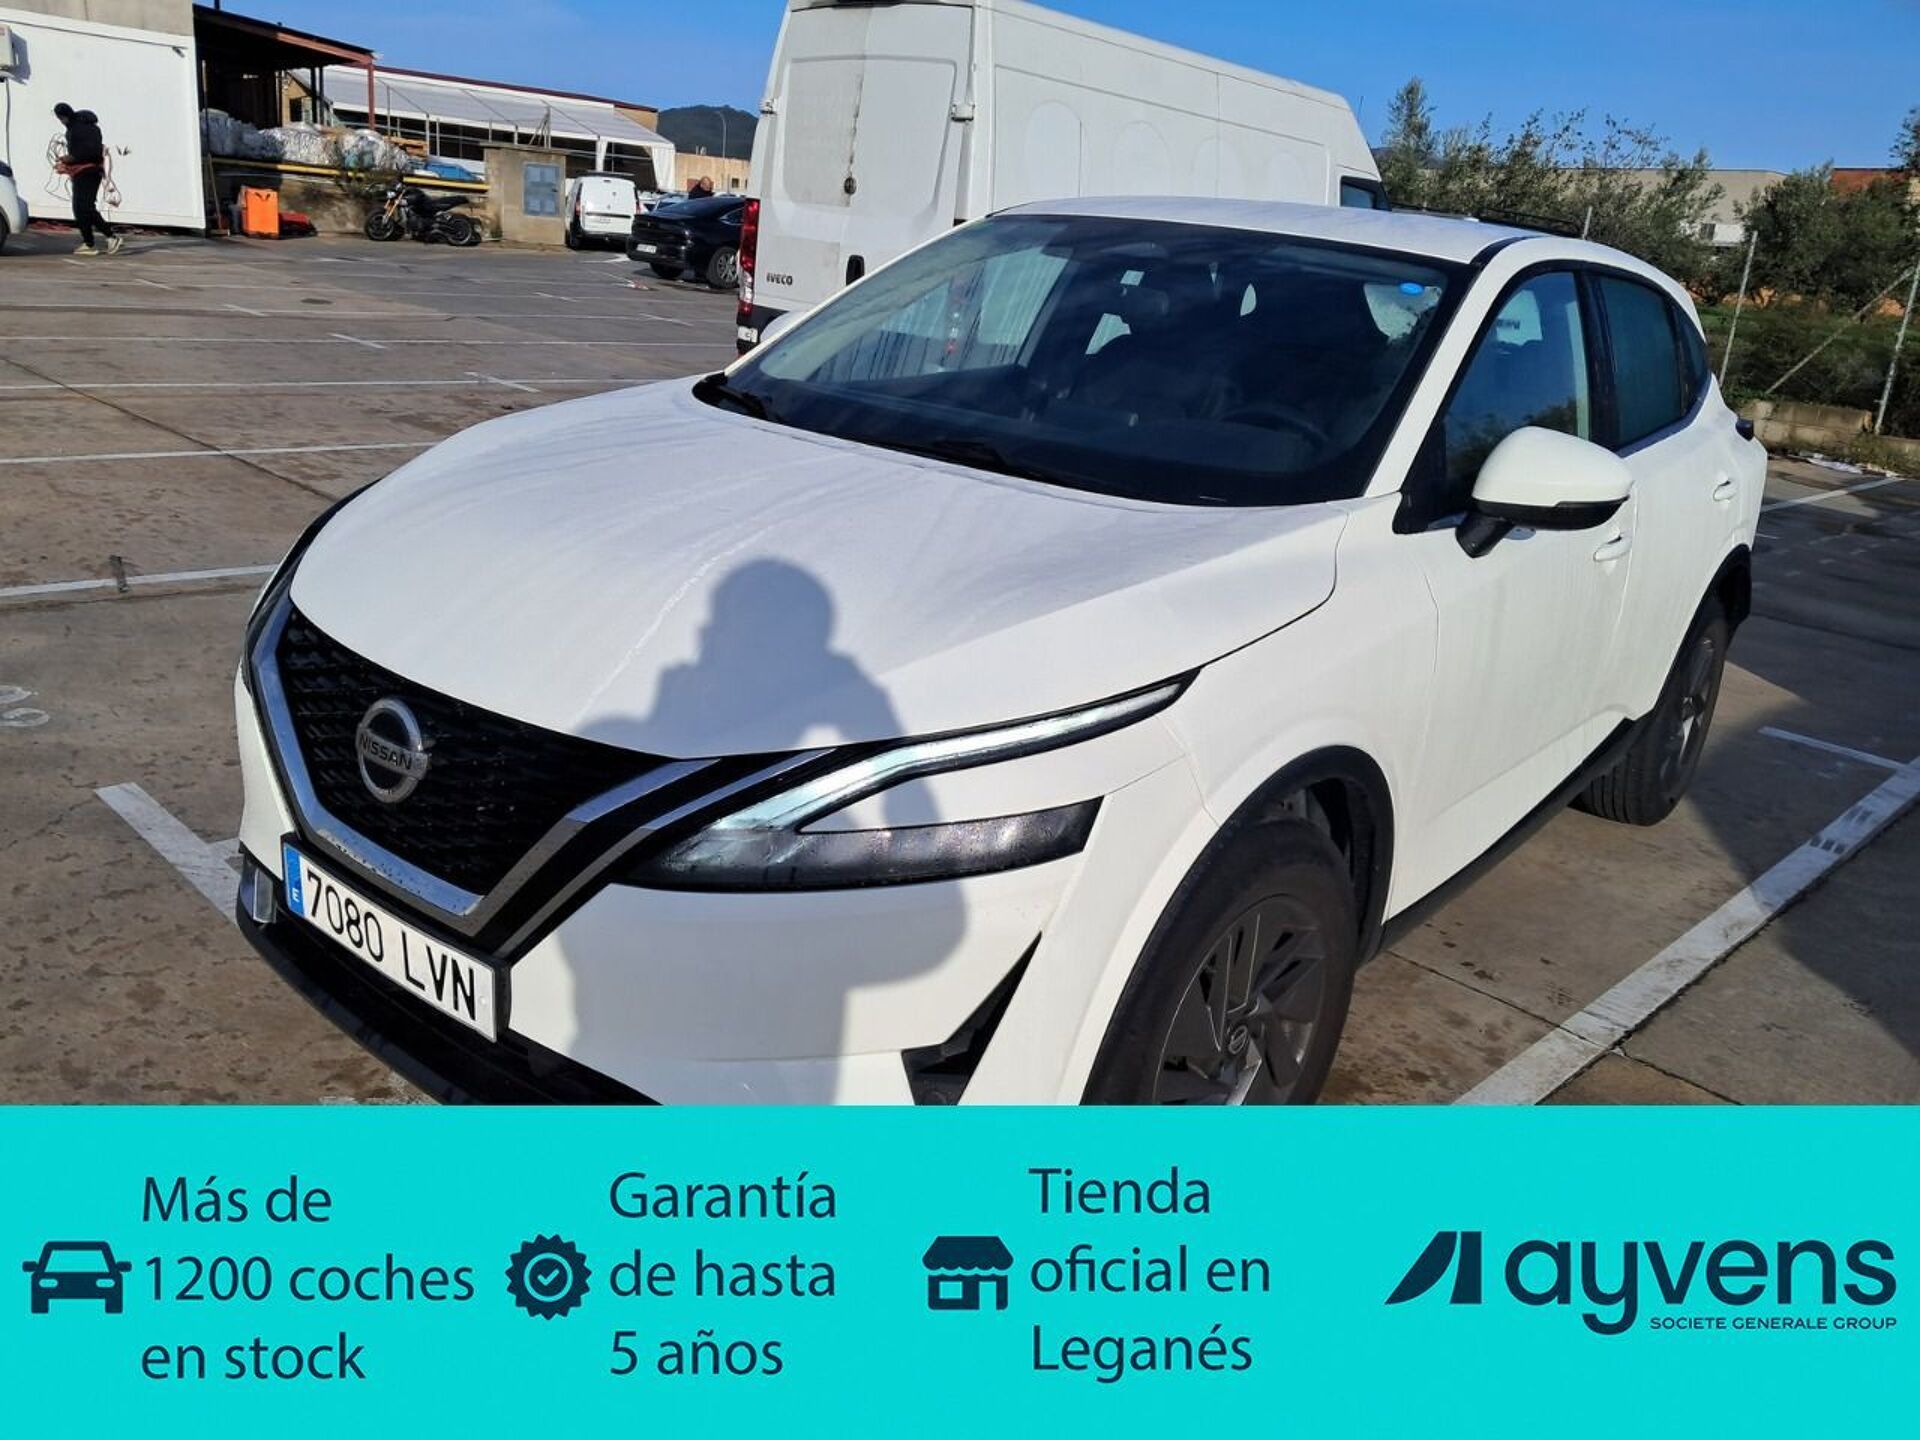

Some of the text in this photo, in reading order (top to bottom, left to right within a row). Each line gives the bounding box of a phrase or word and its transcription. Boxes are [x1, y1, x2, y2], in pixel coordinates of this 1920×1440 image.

[766, 272, 794, 286] IVECO
[360, 732, 413, 771] NISSAN
[291, 887, 300, 903] E
[306, 868, 477, 1021] 7080 LVN
